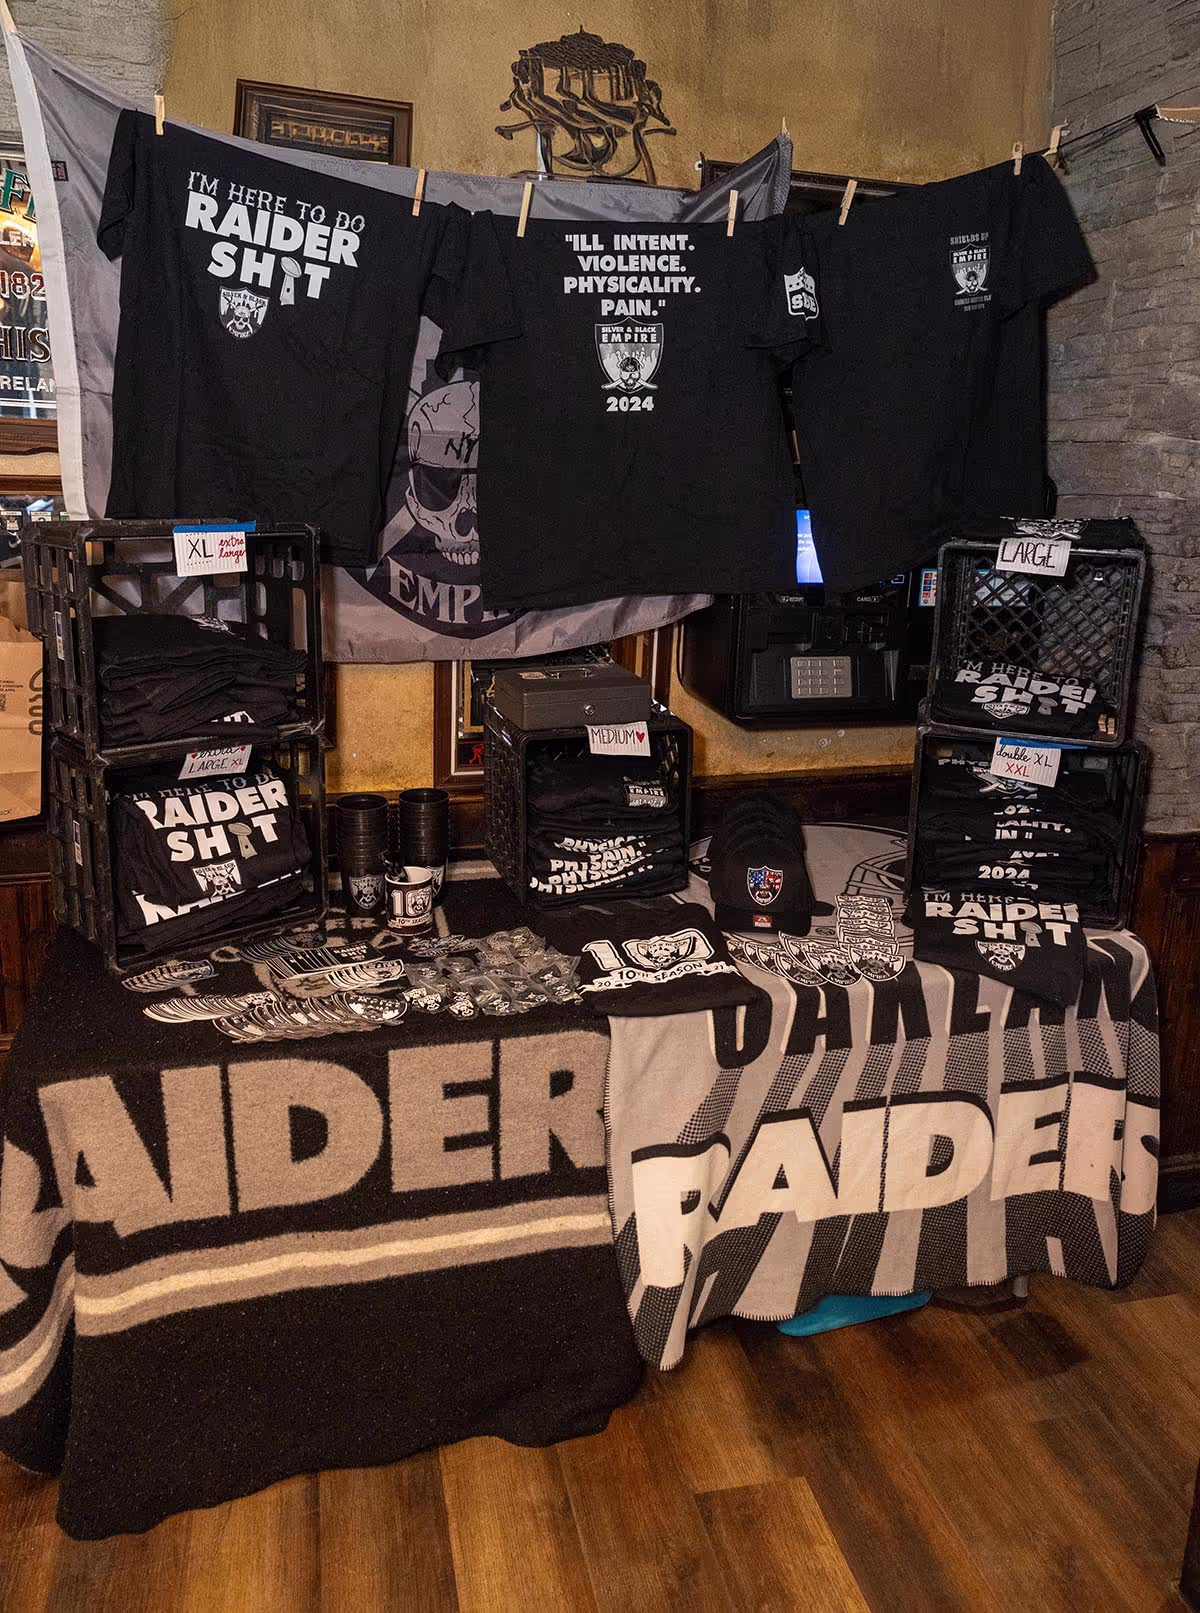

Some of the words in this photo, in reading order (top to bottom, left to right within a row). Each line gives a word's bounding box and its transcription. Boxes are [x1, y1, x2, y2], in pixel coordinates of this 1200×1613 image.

[187, 171, 219, 197] I'M
[227, 183, 287, 214] HERE
[296, 200, 326, 224] TO
[335, 211, 366, 233] DO
[185, 191, 360, 268] RAIDER
[565, 234, 604, 251] "ILL
[613, 234, 695, 251] INTENT.
[577, 255, 687, 272] VIOLENCE.
[953, 252, 987, 264] EMPIRE
[207, 241, 331, 305] SHT
[564, 276, 702, 294] PHYSICALITY.
[601, 299, 666, 316] PAIN."
[601, 333, 657, 343] EMPIRE
[606, 396, 655, 412] 2024
[187, 538, 214, 559] XL
[218, 535, 245, 548] extra
[218, 547, 248, 564] large
[1000, 541, 1059, 569] LARGE
[991, 661, 1043, 682] HERE
[1052, 675, 1079, 687] TO
[970, 685, 1087, 716] SHT
[591, 728, 636, 745] MEDIUM
[996, 744, 1031, 762] double
[1033, 753, 1053, 768] XL
[188, 758, 228, 774] LARGE
[230, 758, 243, 768] XL
[1005, 762, 1031, 778] XXL
[216, 776, 247, 793] TO
[135, 779, 289, 830] RAIDER
[166, 813, 280, 862] SHT
[977, 864, 1031, 880] 2024
[952, 918, 1072, 947] SHT
[654, 962, 704, 982] SEASON
